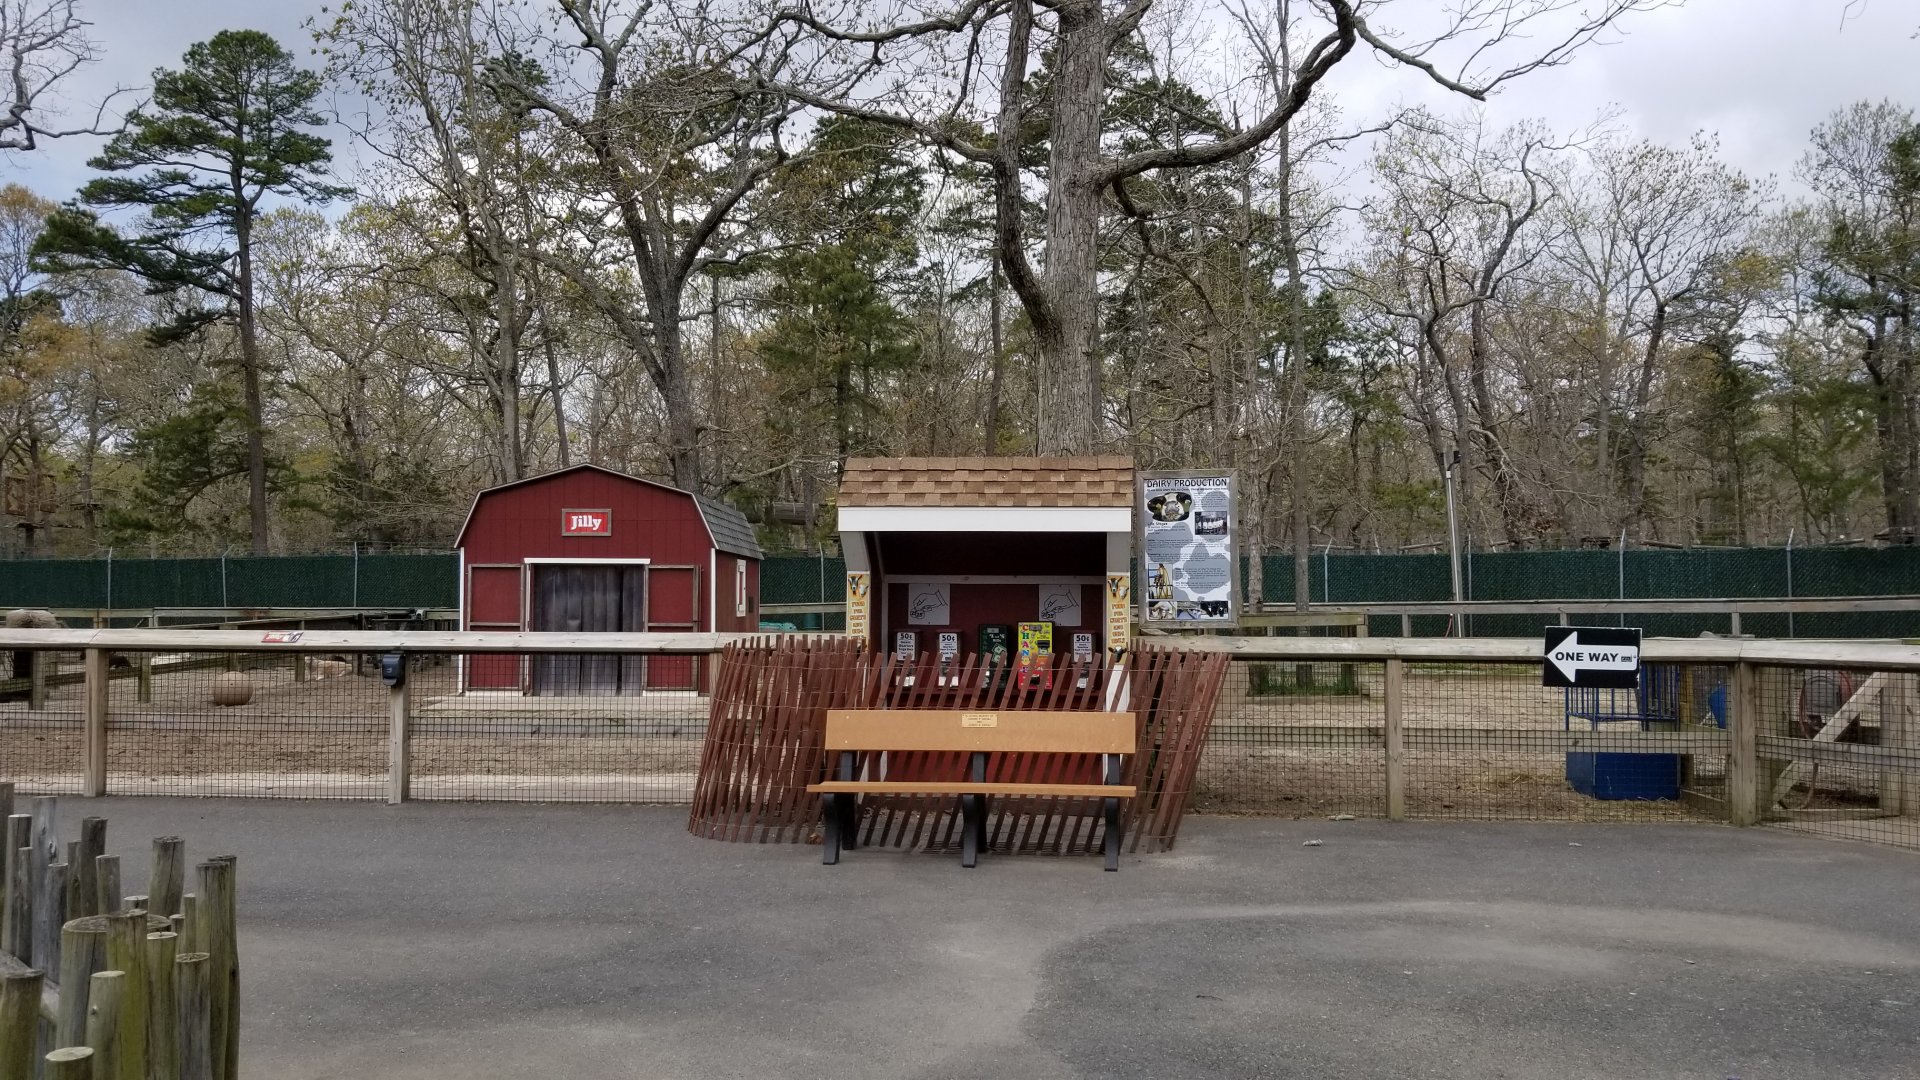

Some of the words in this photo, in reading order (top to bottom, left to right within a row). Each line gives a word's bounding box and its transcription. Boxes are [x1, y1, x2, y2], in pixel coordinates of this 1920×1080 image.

[1147, 479, 1172, 488] DAIRY
[1174, 478, 1228, 487] PRODUCTION
[570, 515, 602, 531] Jilly
[1555, 651, 1584, 661] ONE
[1589, 652, 1619, 662] WAY
